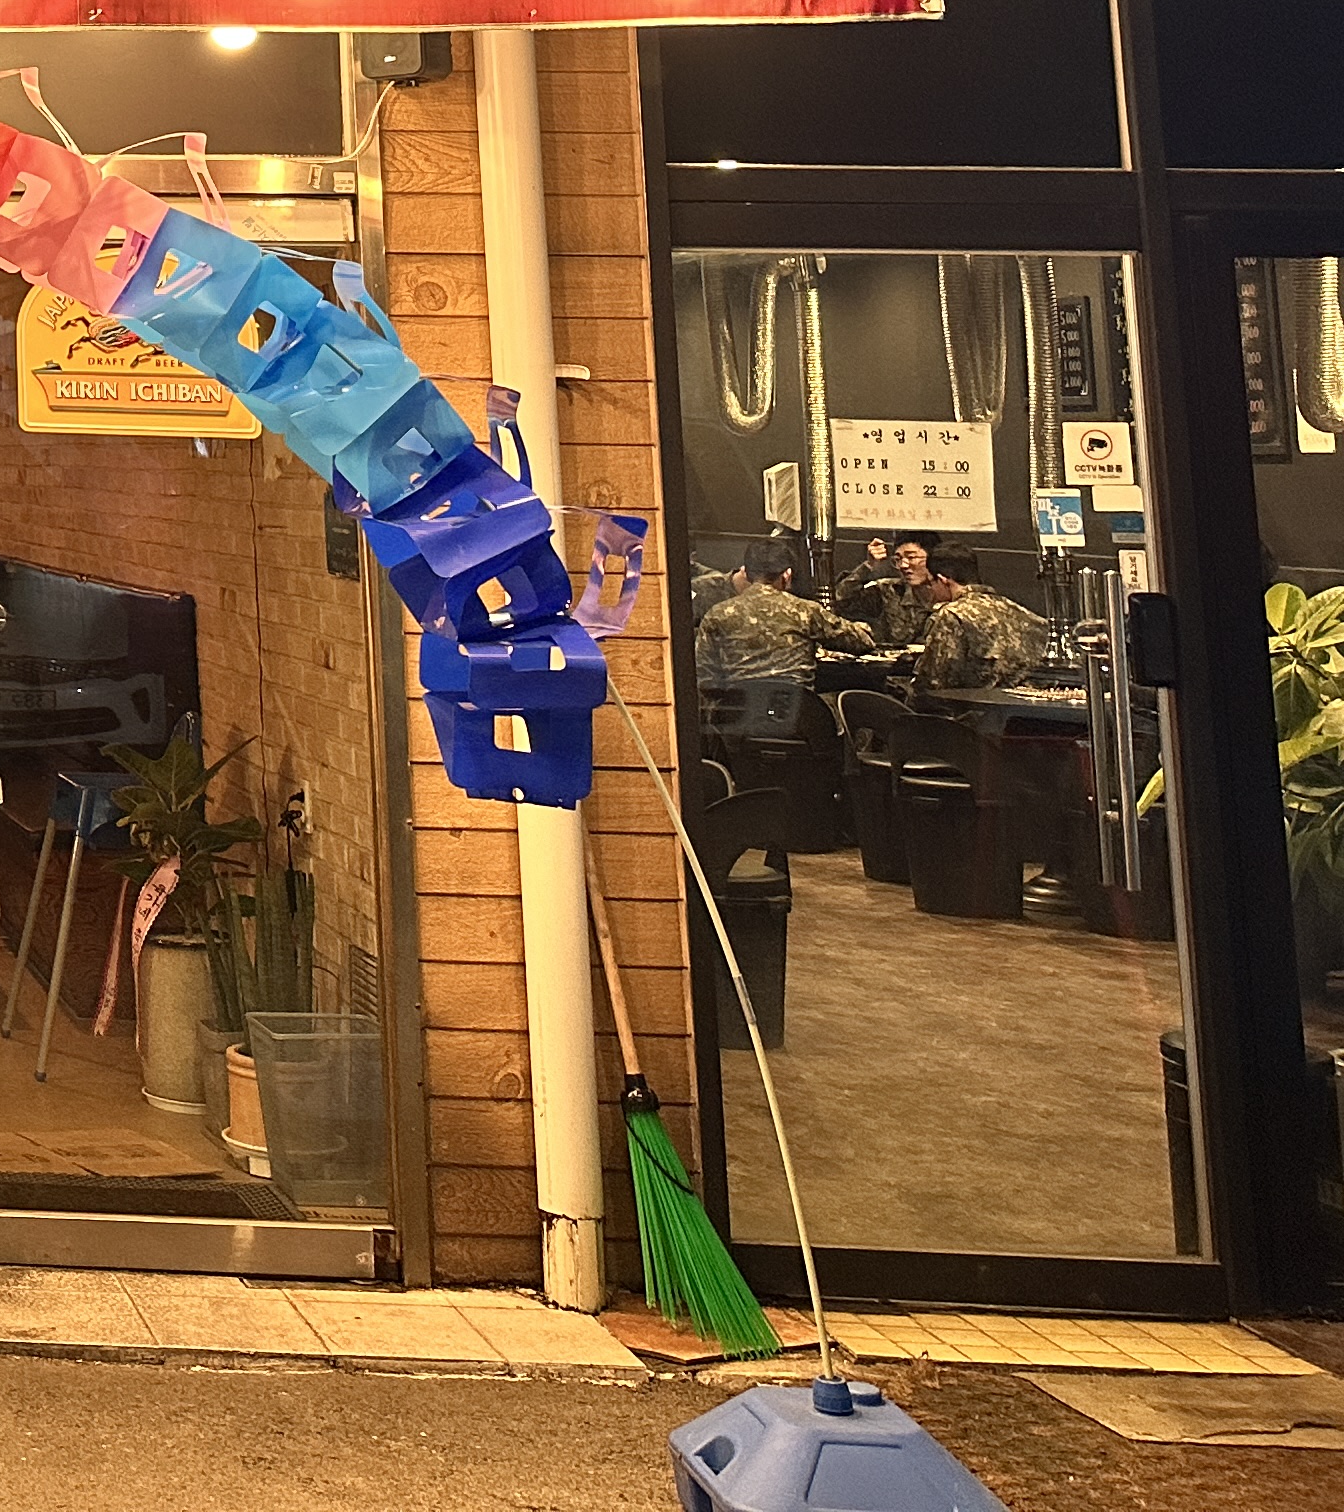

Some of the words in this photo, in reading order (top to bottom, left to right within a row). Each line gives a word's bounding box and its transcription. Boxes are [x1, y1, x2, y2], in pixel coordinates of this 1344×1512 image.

[87, 357, 125, 367] DRAFT
[55, 379, 118, 400] KIRIN
[130, 381, 223, 403] ICHIBAN
[841, 458, 888, 470] OPEN
[842, 482, 904, 495] CLOSE
